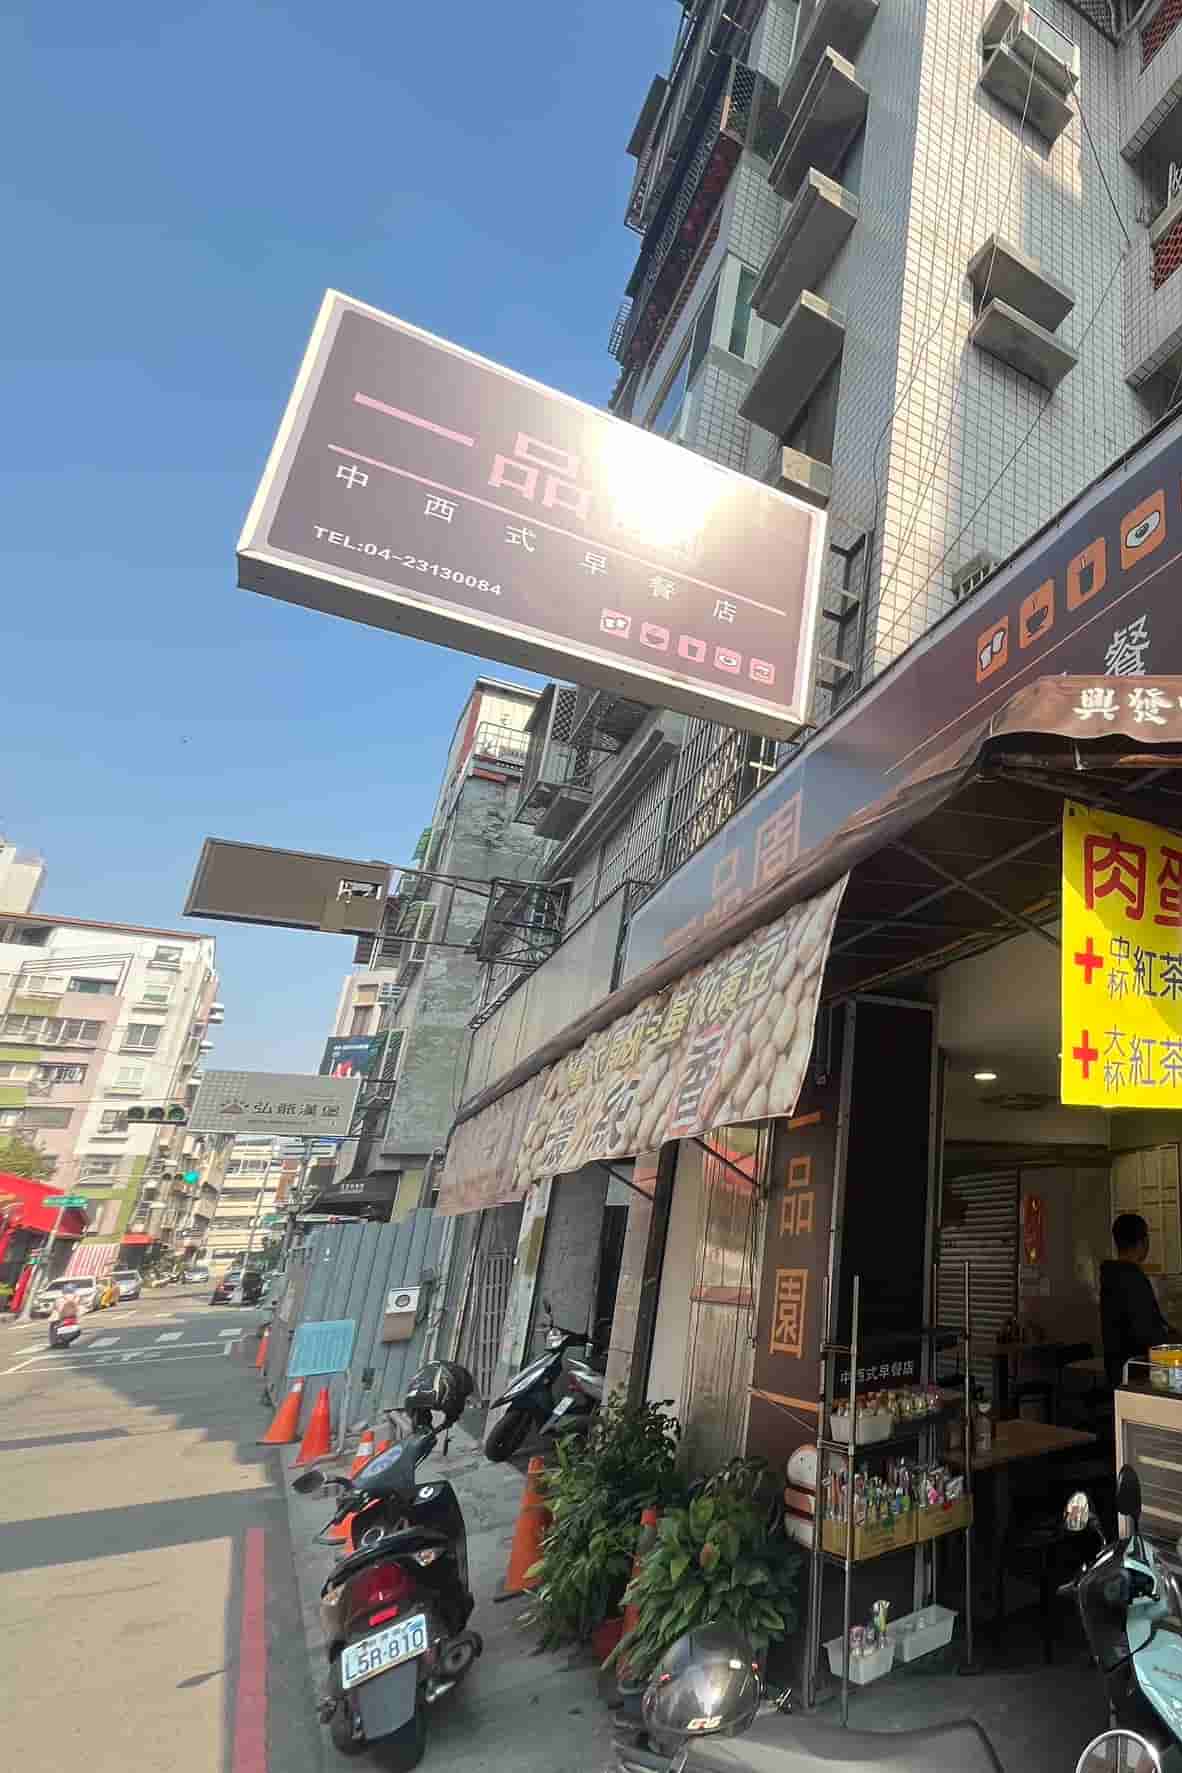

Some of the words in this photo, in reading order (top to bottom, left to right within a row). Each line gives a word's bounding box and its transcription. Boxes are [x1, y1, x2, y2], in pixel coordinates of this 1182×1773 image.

[312, 525, 503, 598] TEL:04-23130084
[334, 463, 740, 624] 中西式早餐店
